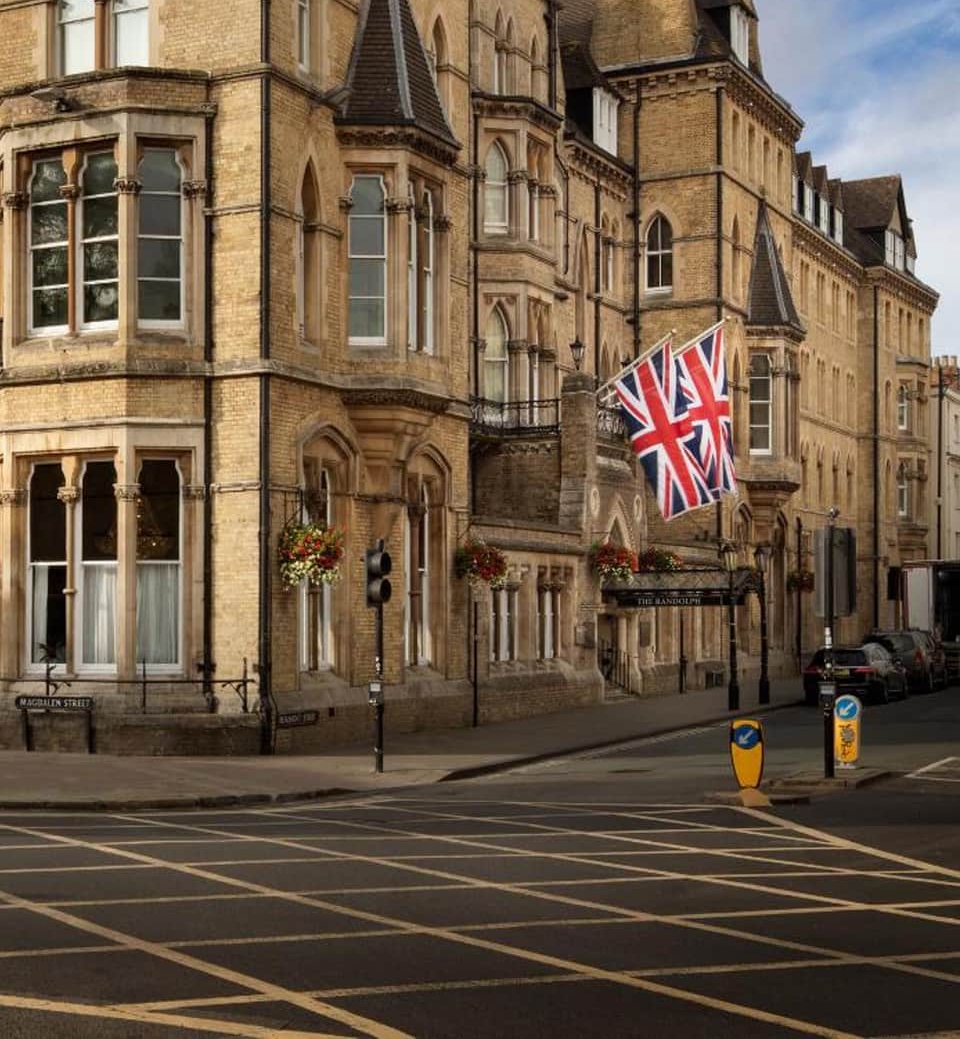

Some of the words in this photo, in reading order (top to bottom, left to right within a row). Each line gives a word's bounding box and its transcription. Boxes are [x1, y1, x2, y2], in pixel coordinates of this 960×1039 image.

[638, 597, 652, 605] THE
[655, 597, 701, 605] RANDOLPH
[19, 698, 61, 707] MAGDALEN
[63, 699, 90, 707] STREET
